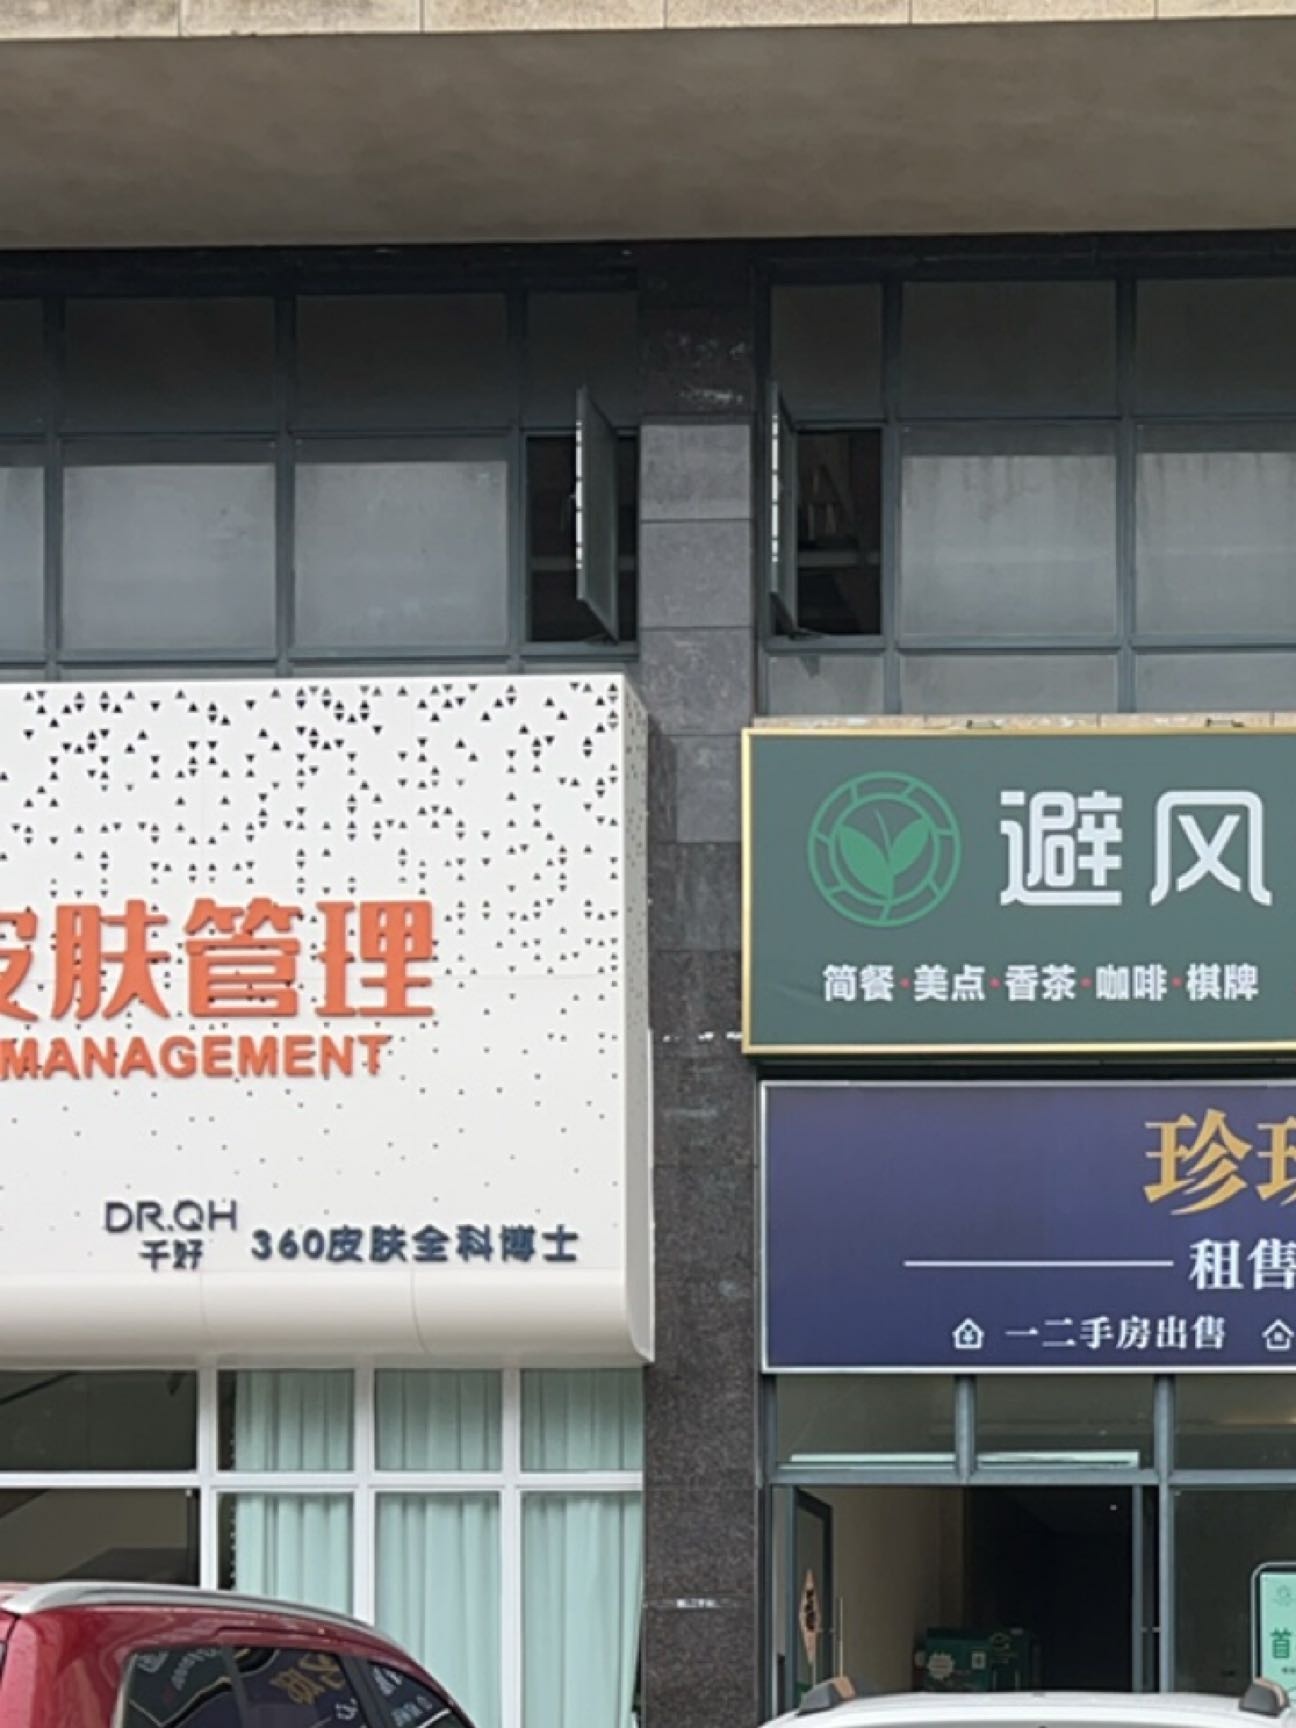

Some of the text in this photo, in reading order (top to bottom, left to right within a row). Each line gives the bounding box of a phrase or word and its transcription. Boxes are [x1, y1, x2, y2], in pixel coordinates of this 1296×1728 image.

[0, 1033, 391, 1080] MANAGEMENT
[251, 1223, 579, 1263] 360皮肤全科博士
[1004, 1315, 1226, 1350] 一二手房出售
